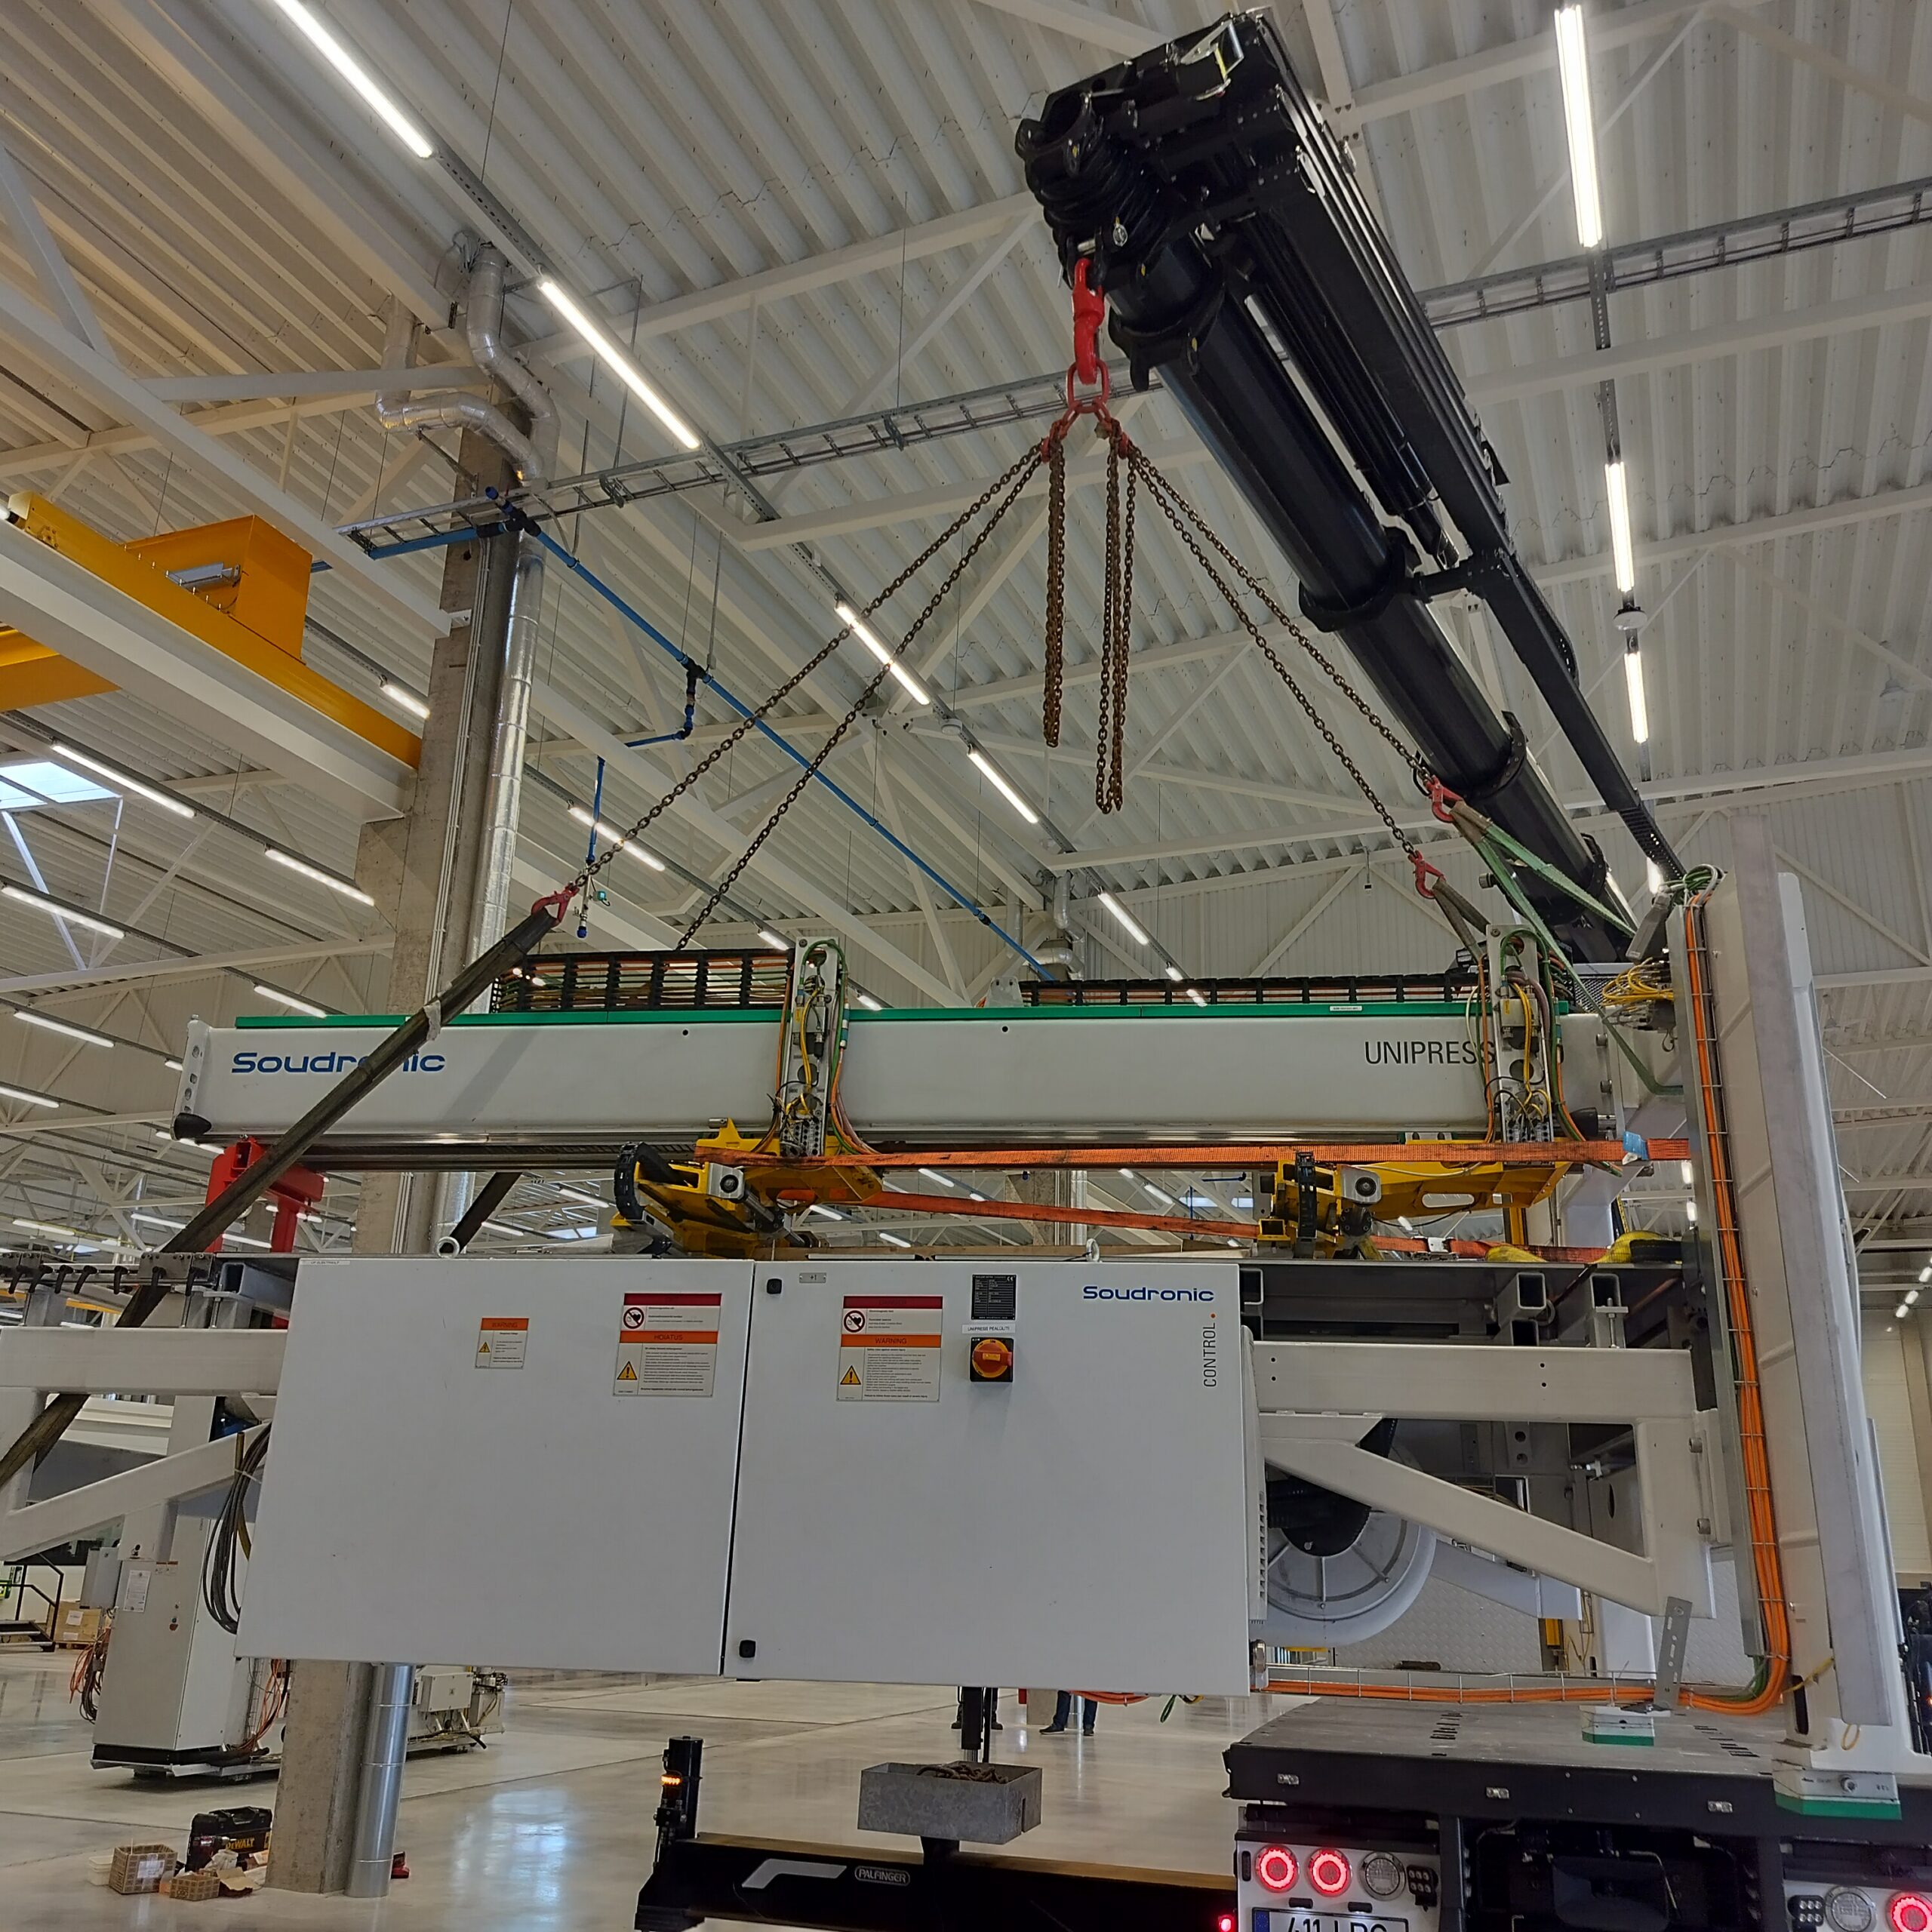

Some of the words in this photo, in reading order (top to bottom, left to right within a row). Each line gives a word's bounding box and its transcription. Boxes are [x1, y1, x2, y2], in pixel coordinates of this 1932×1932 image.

[232, 1052, 445, 1073] Soudric
[1364, 1041, 1496, 1065] UNIPRESS
[1083, 1285, 1214, 1301] Soudronic
[1202, 1322, 1217, 1387] CONTROL
[859, 1869, 906, 1884] PALFINGER
